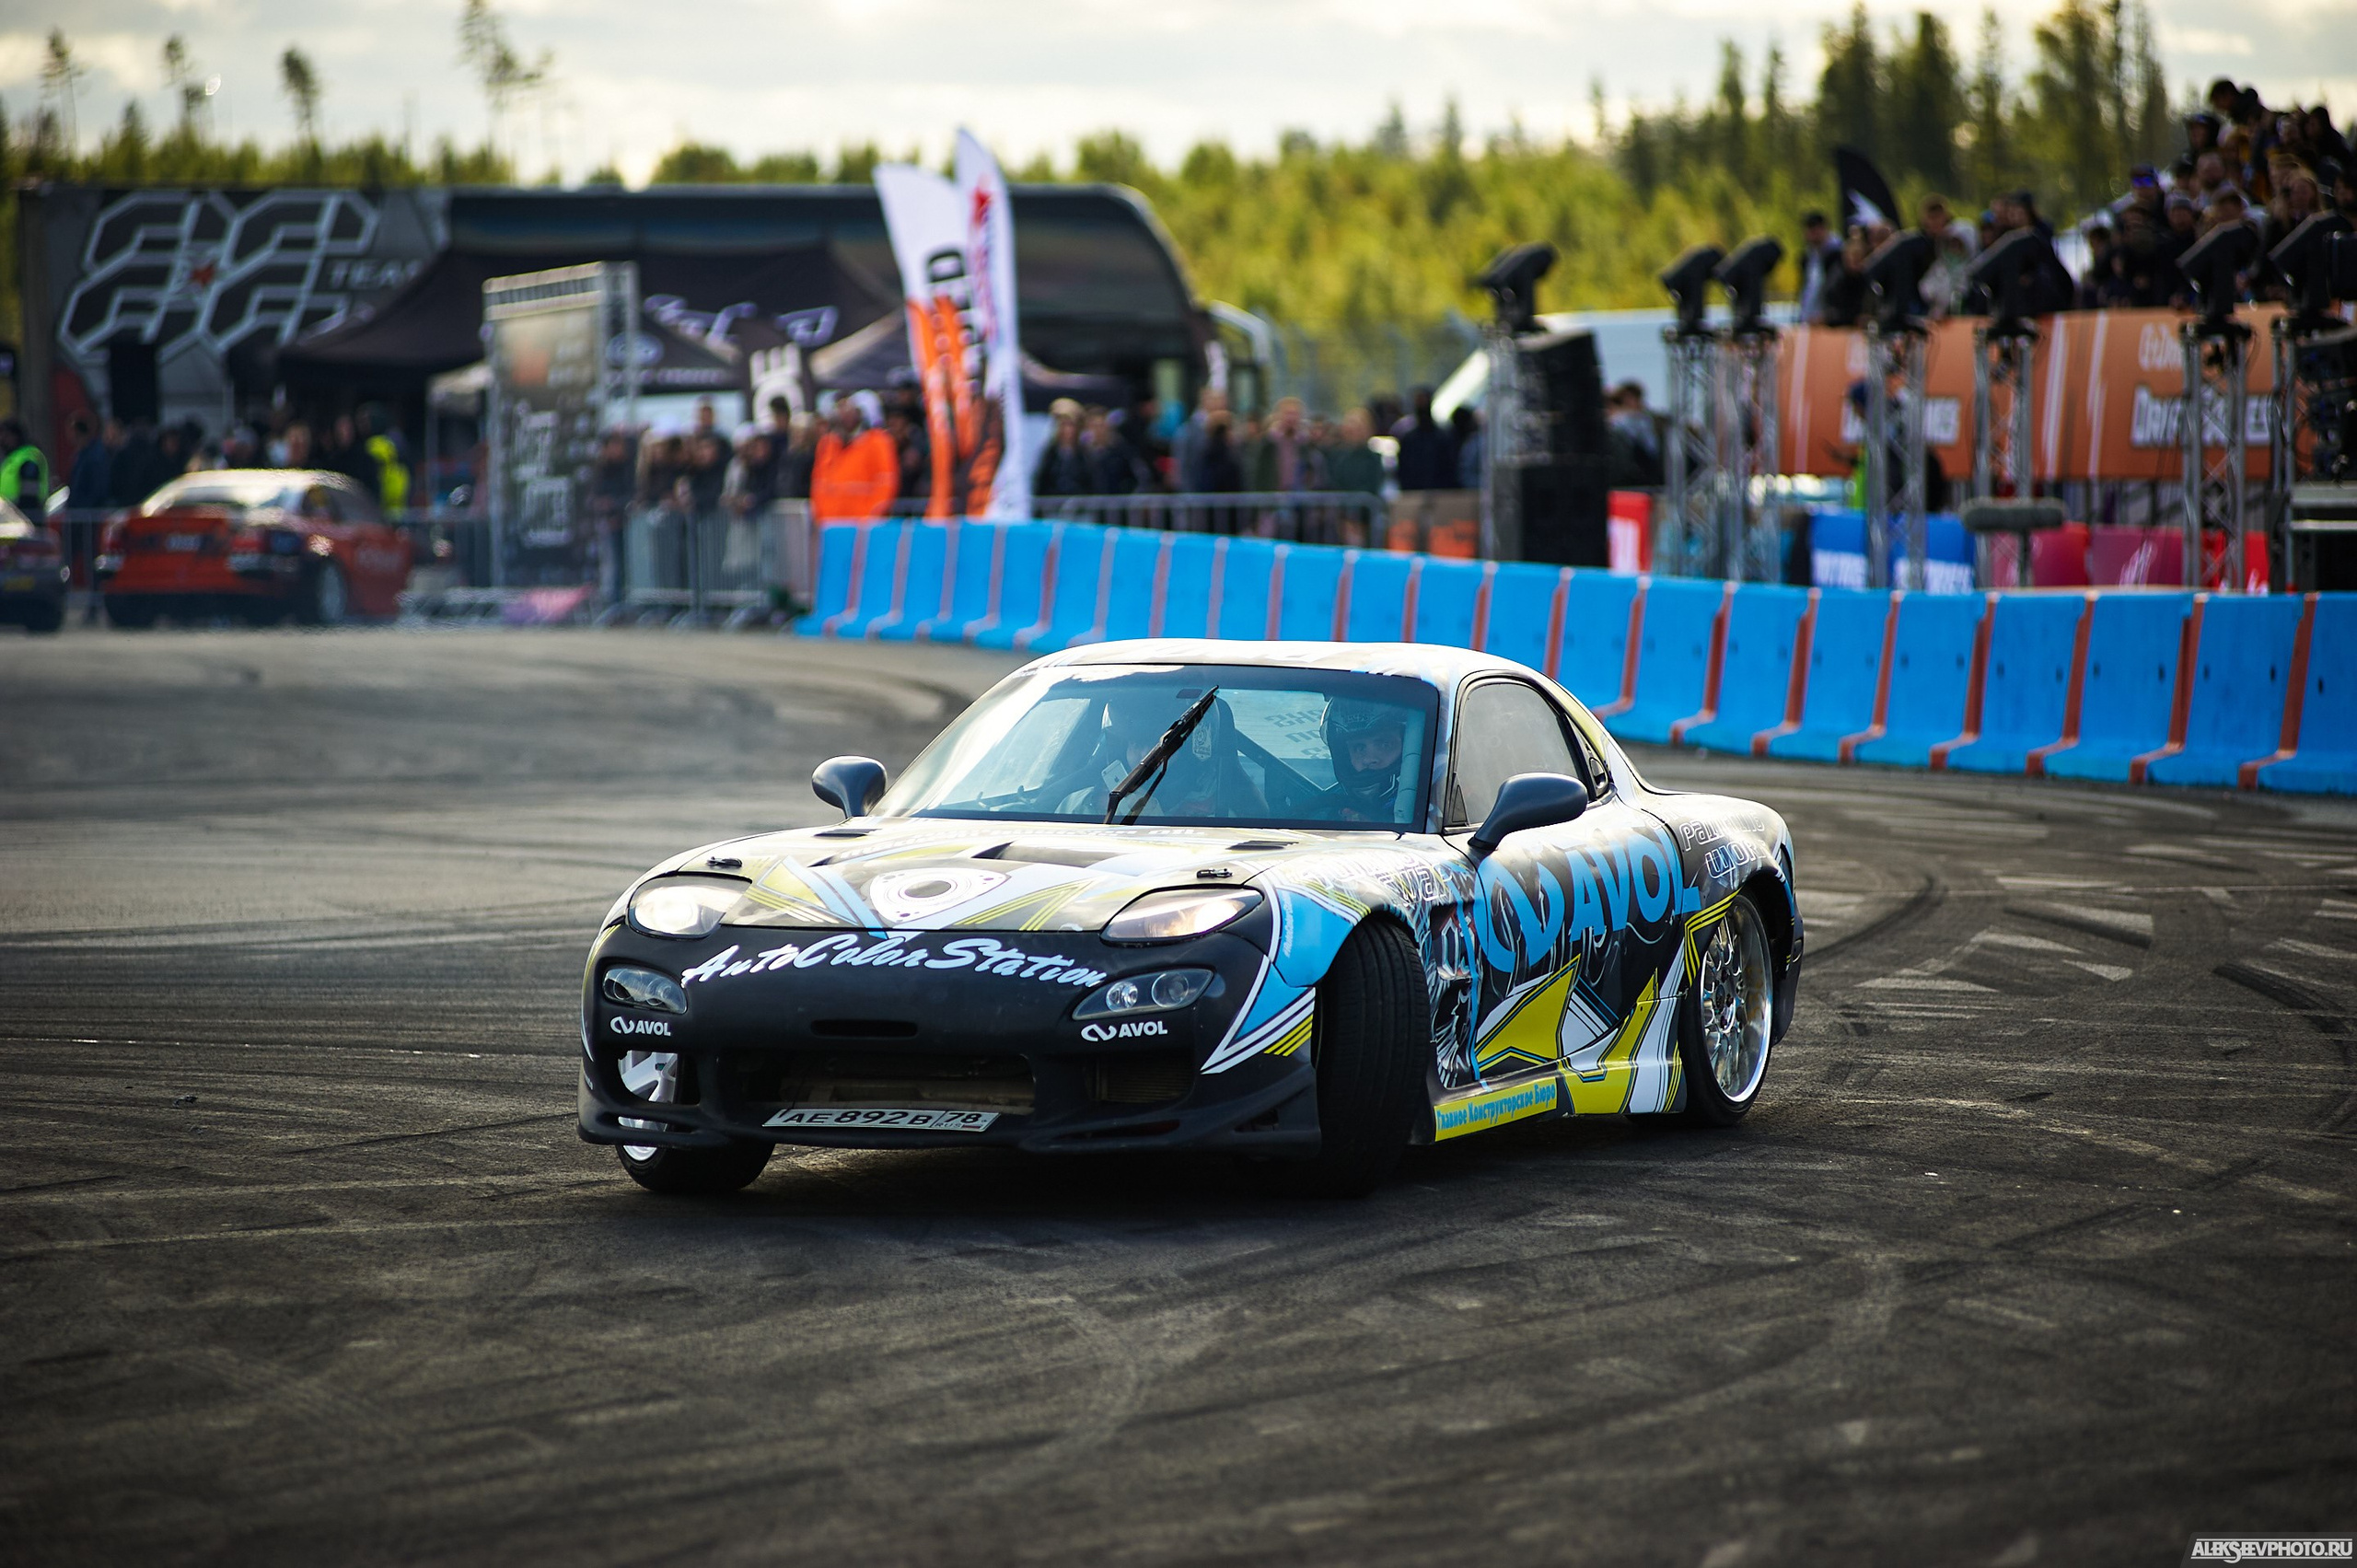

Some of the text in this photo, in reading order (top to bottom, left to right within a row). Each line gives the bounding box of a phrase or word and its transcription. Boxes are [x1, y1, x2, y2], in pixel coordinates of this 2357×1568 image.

[1569, 827, 1702, 943] AVOL
[635, 1019, 671, 1037] AVOL
[1118, 1019, 1168, 1039] AVOL
[1436, 1083, 1556, 1131] Главное Конструкторское Бюро
[944, 1111, 982, 1124] 78
